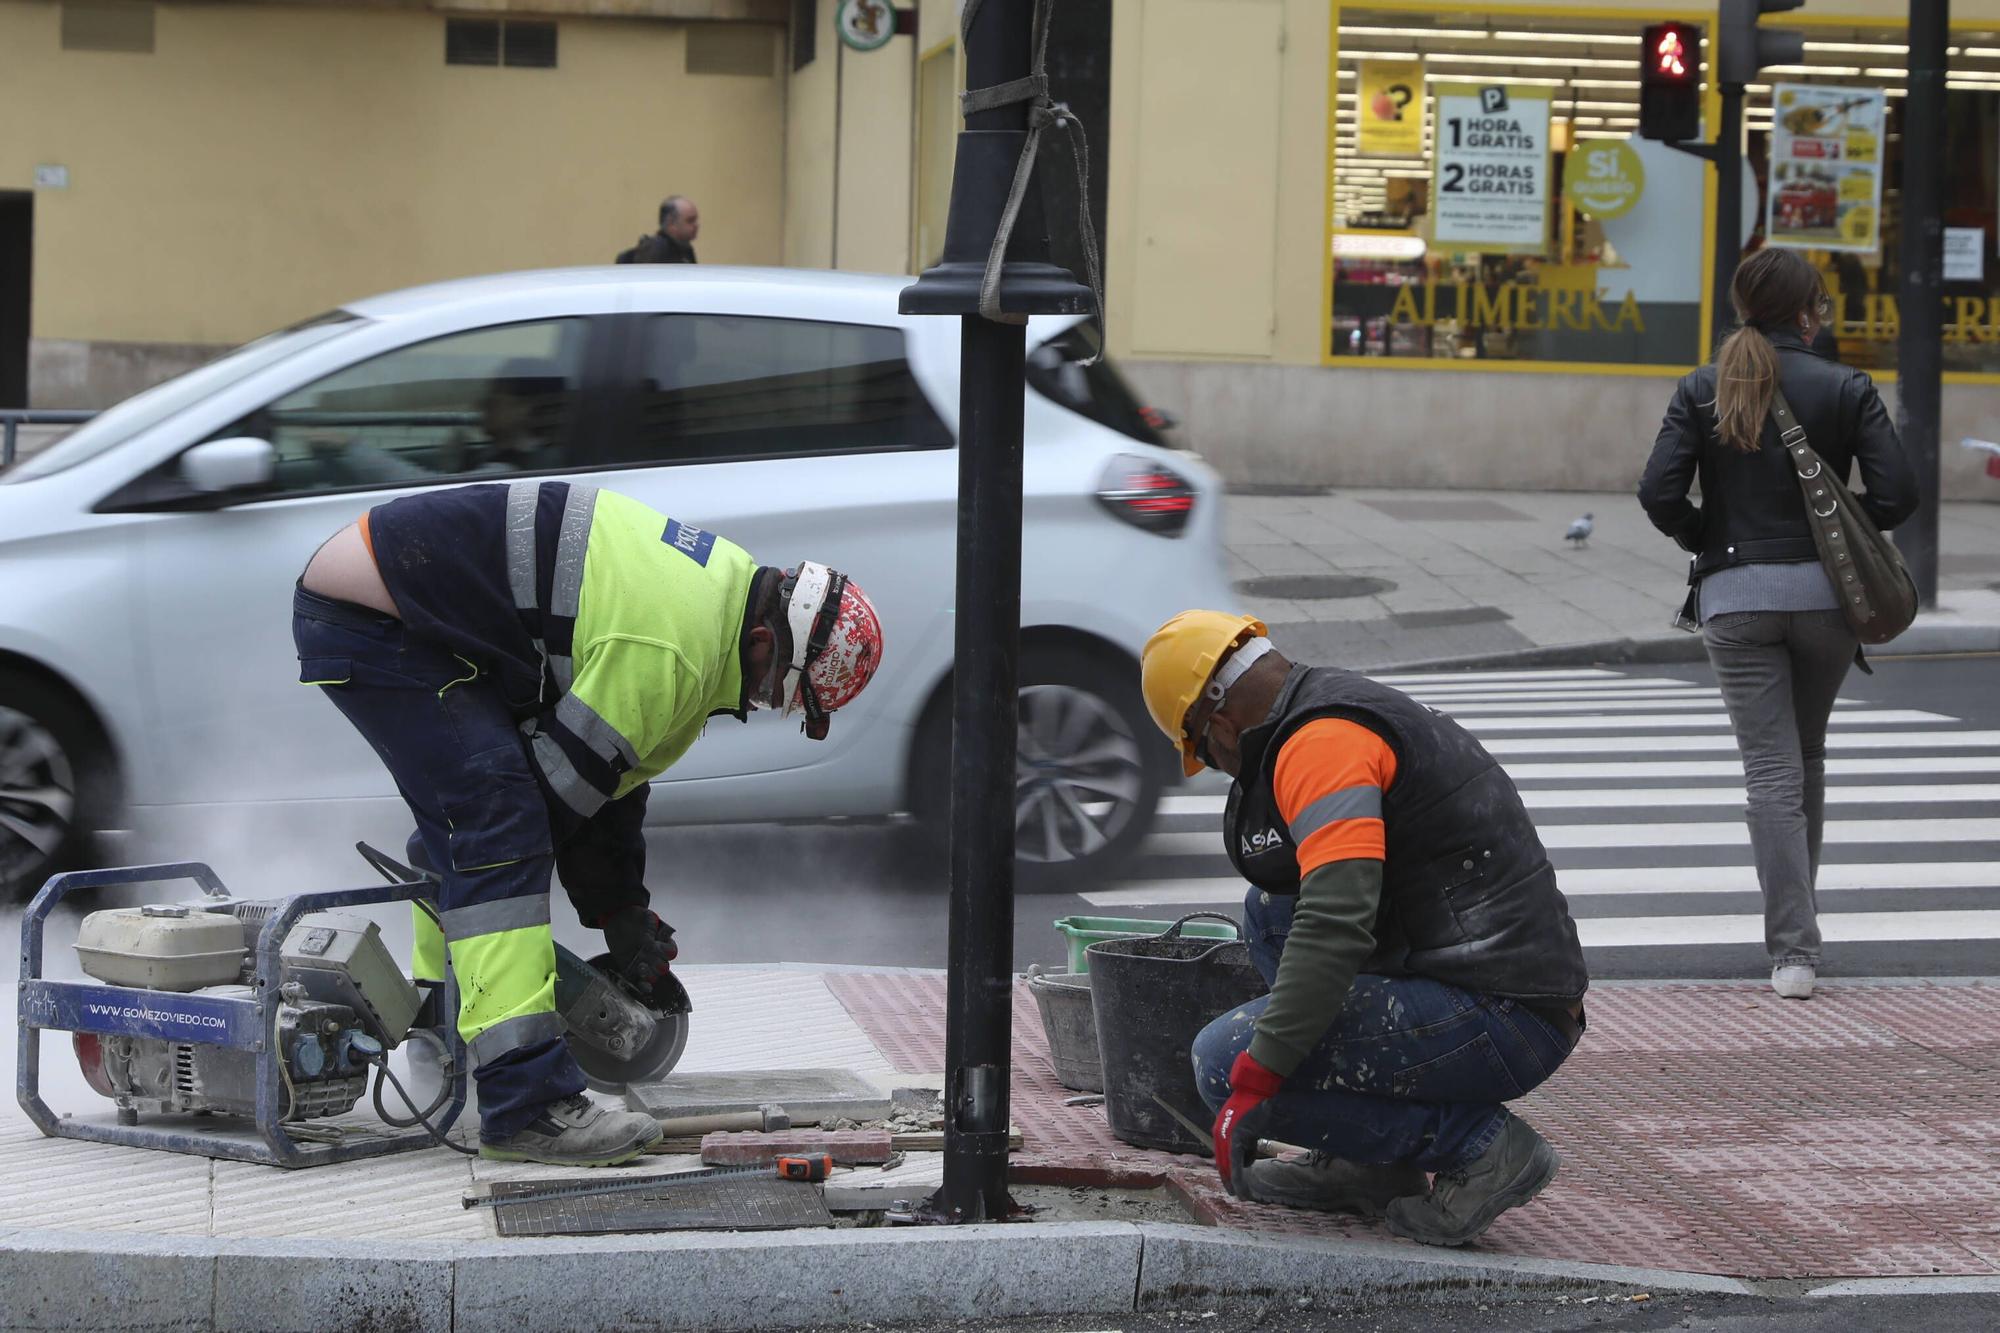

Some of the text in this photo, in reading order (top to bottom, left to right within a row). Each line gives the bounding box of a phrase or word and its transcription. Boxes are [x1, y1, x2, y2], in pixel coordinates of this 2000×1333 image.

[1448, 117, 1521, 147] 1 HORA
[1467, 133, 1534, 149] GRATIS
[1442, 162, 1534, 193] 2 HORAS
[1468, 180, 1535, 195] GRATIS
[1389, 277, 1646, 333] ALIMERKA
[89, 1003, 226, 1029] WWW.GOMEZOVIEDO.COM
